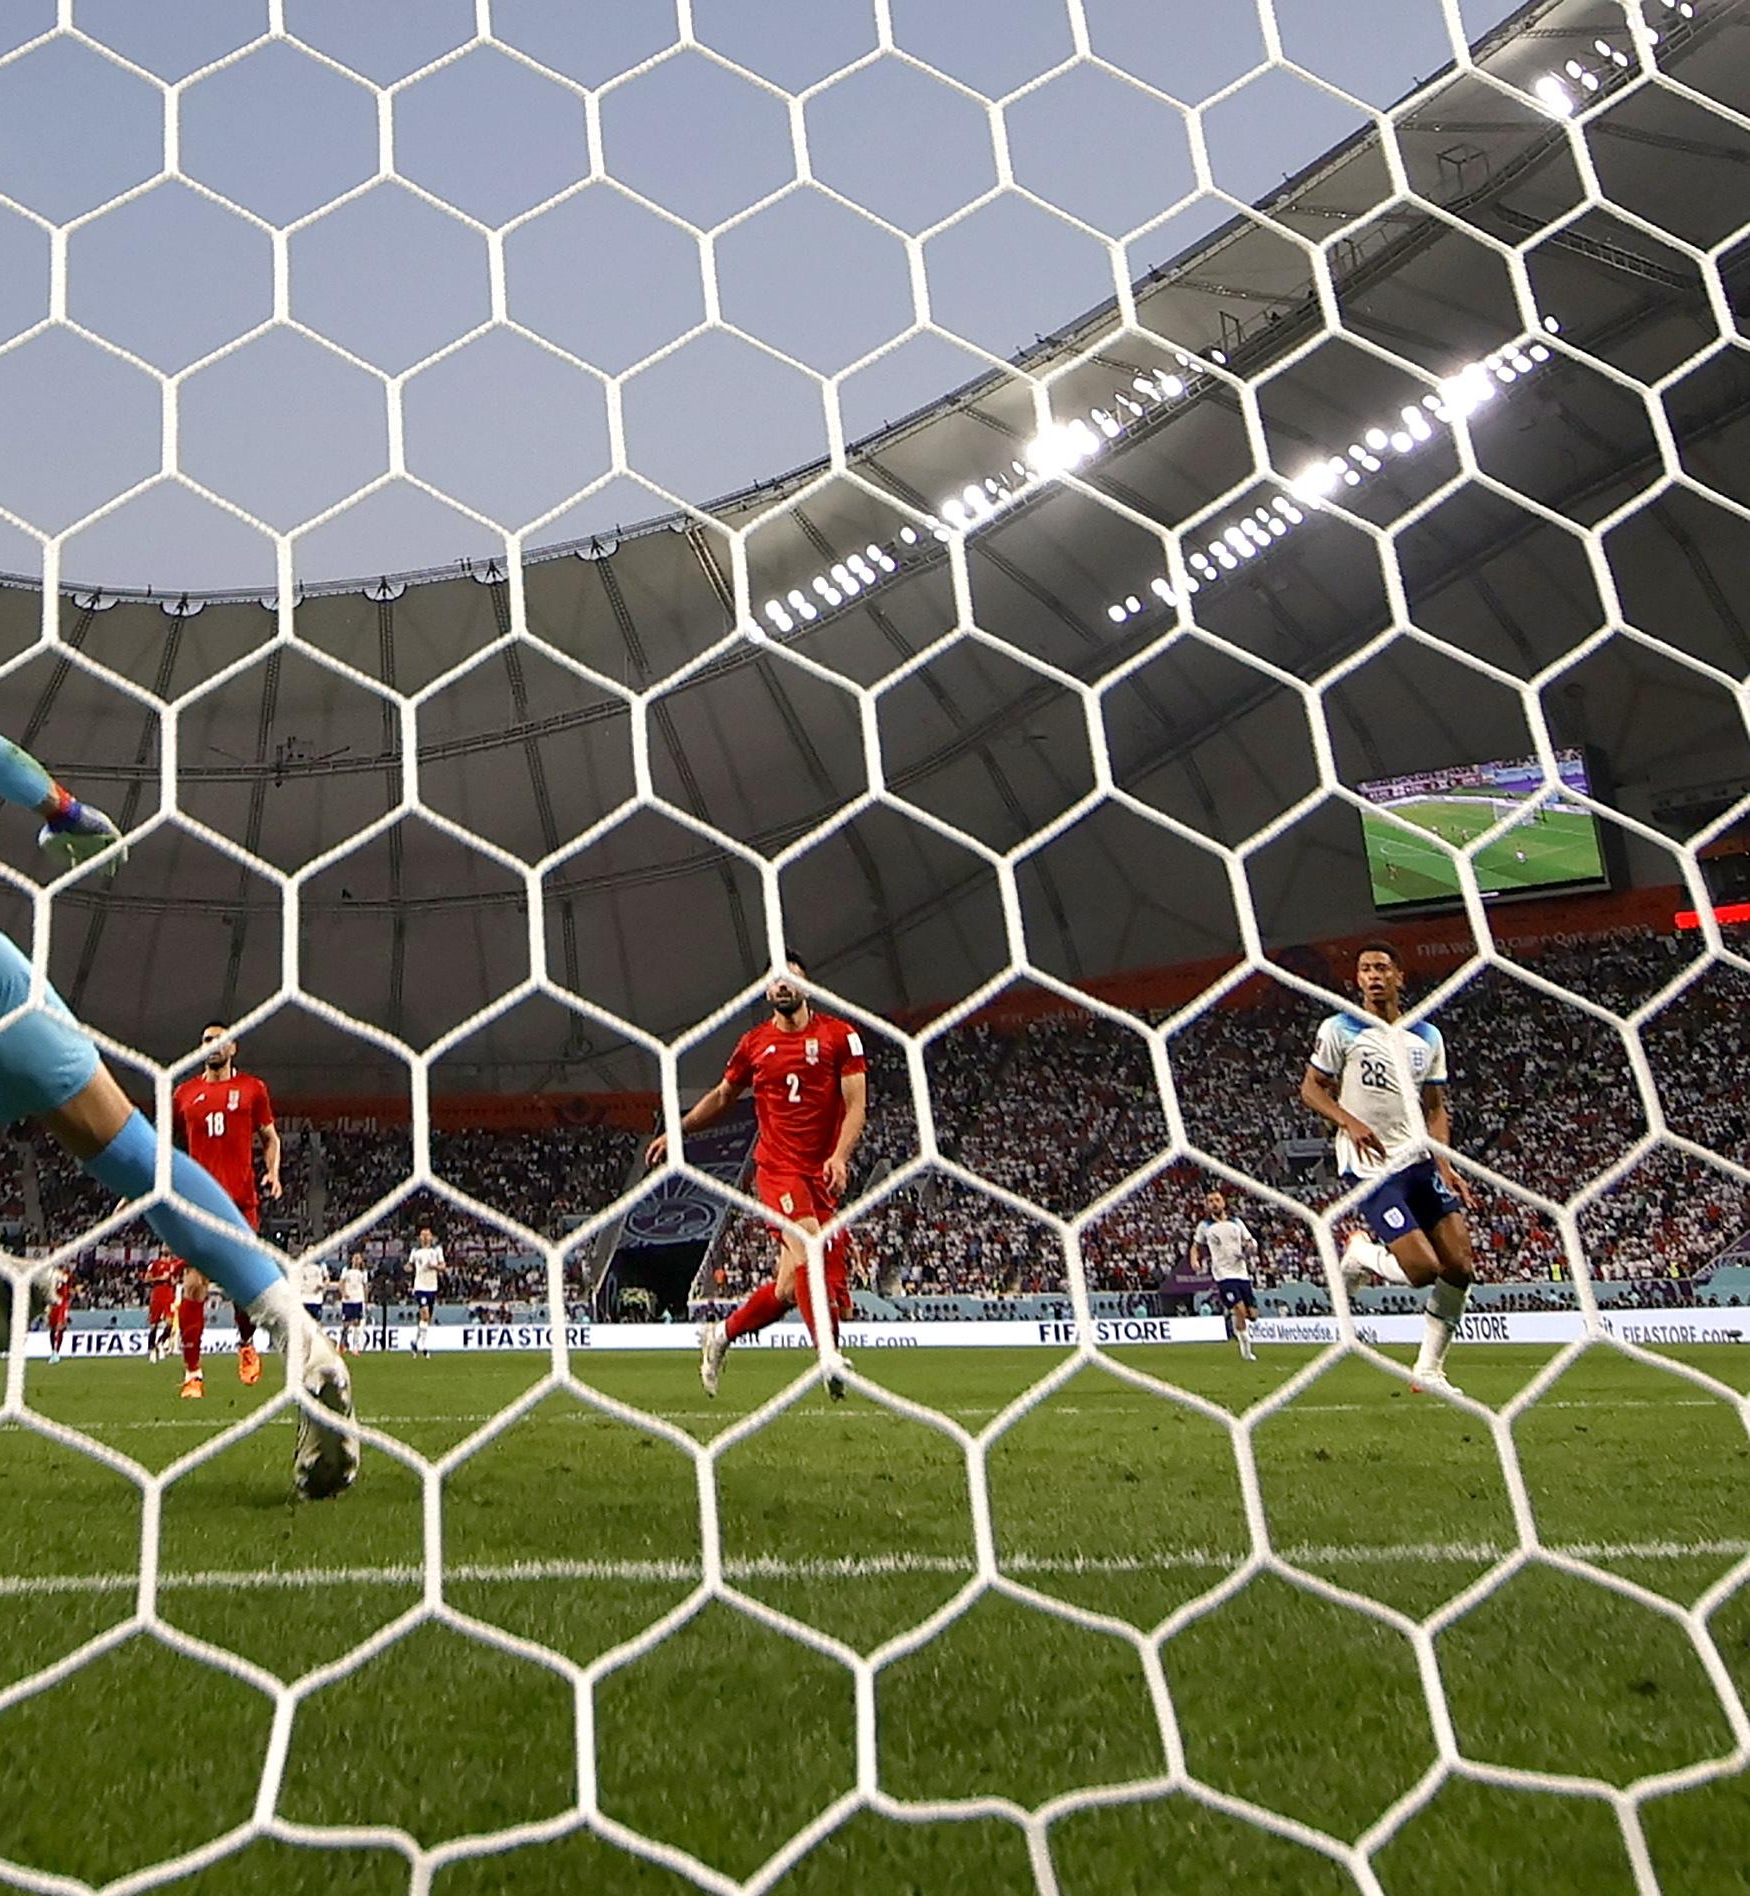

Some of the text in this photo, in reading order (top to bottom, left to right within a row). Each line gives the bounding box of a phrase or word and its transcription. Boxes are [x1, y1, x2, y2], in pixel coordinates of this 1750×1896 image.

[786, 1073, 801, 1103] 2
[205, 1111, 225, 1138] 18
[463, 1328, 513, 1346] FIFA
[1039, 1321, 1171, 1342] FIF STORE
[1467, 1316, 1510, 1340] STORE
[71, 1334, 125, 1354] FIFA
